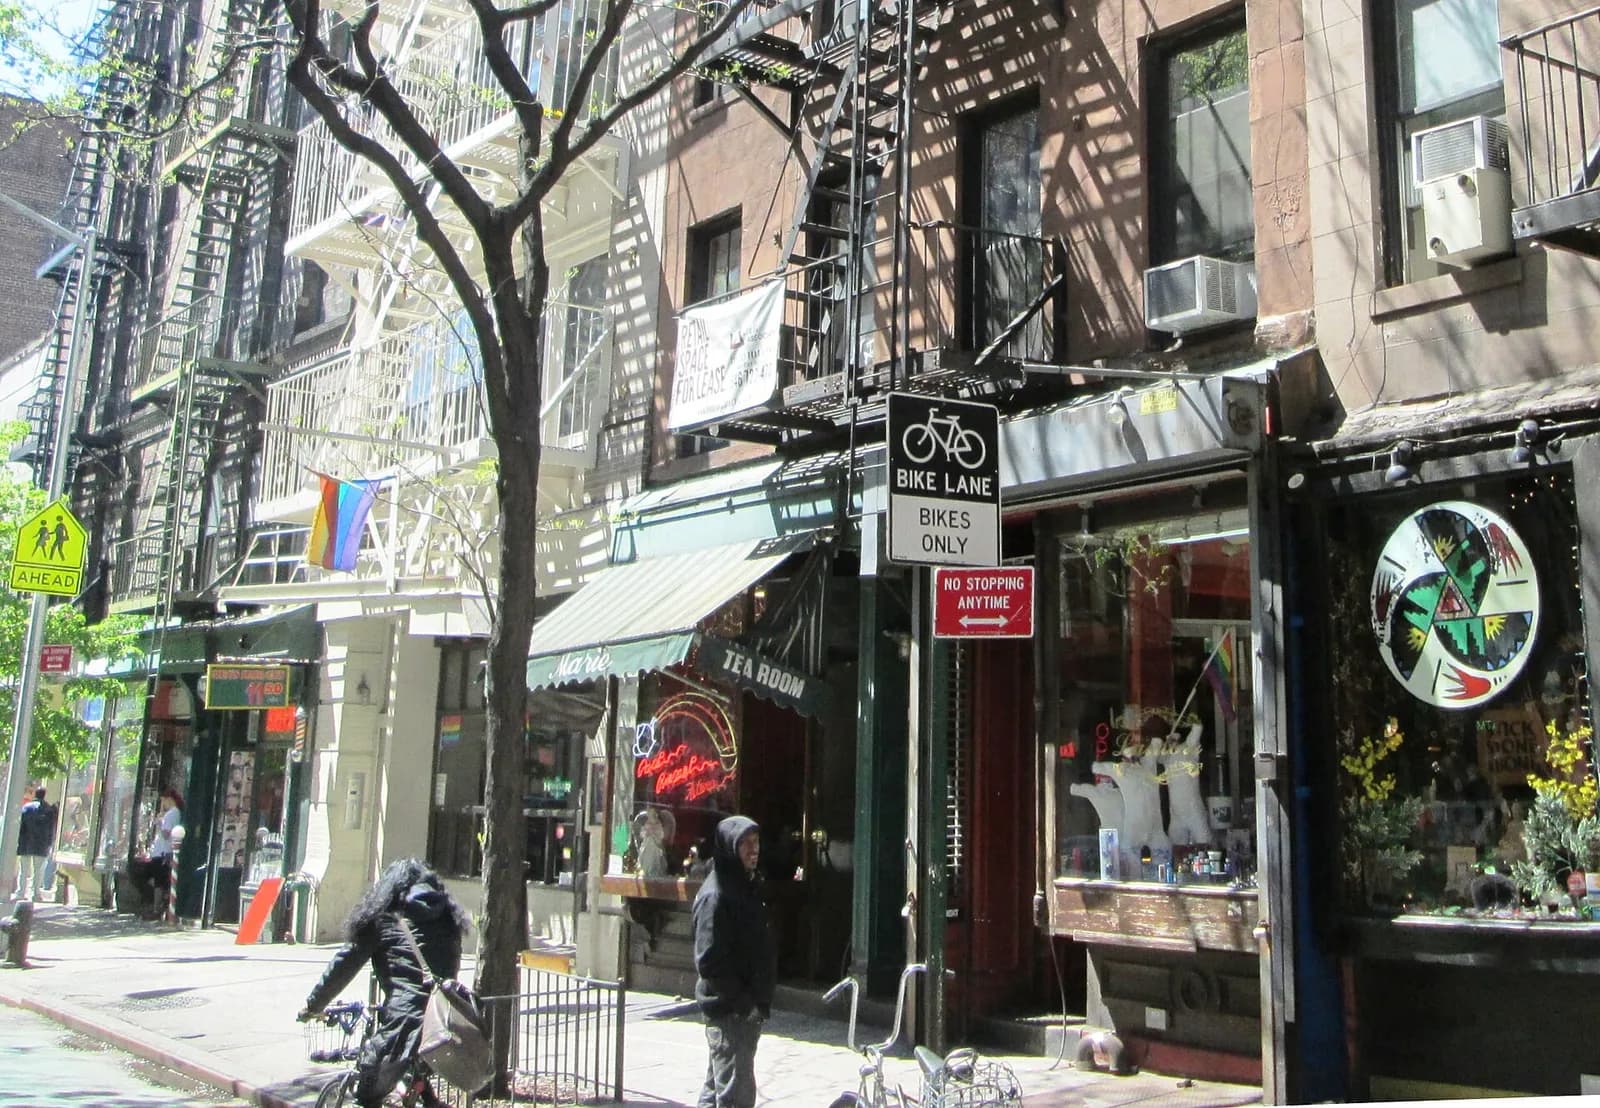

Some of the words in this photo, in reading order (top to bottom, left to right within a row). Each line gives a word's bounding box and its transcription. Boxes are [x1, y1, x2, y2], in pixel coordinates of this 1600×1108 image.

[680, 318, 710, 350] RETAIL
[678, 343, 710, 378] SPACE
[675, 375, 695, 405] FOR
[696, 365, 727, 399] LEASE
[897, 468, 937, 491] BIKE
[944, 474, 992, 497] LANE
[919, 507, 971, 530] BIKES
[922, 534, 968, 555] ONLY
[17, 571, 75, 588] AHEAD
[944, 577, 961, 591] NO
[966, 577, 1025, 591] STOPPING
[957, 595, 1010, 610] ANYTIME
[549, 652, 613, 680] Marie
[722, 649, 753, 679] TEA
[756, 663, 805, 699] ROOM
